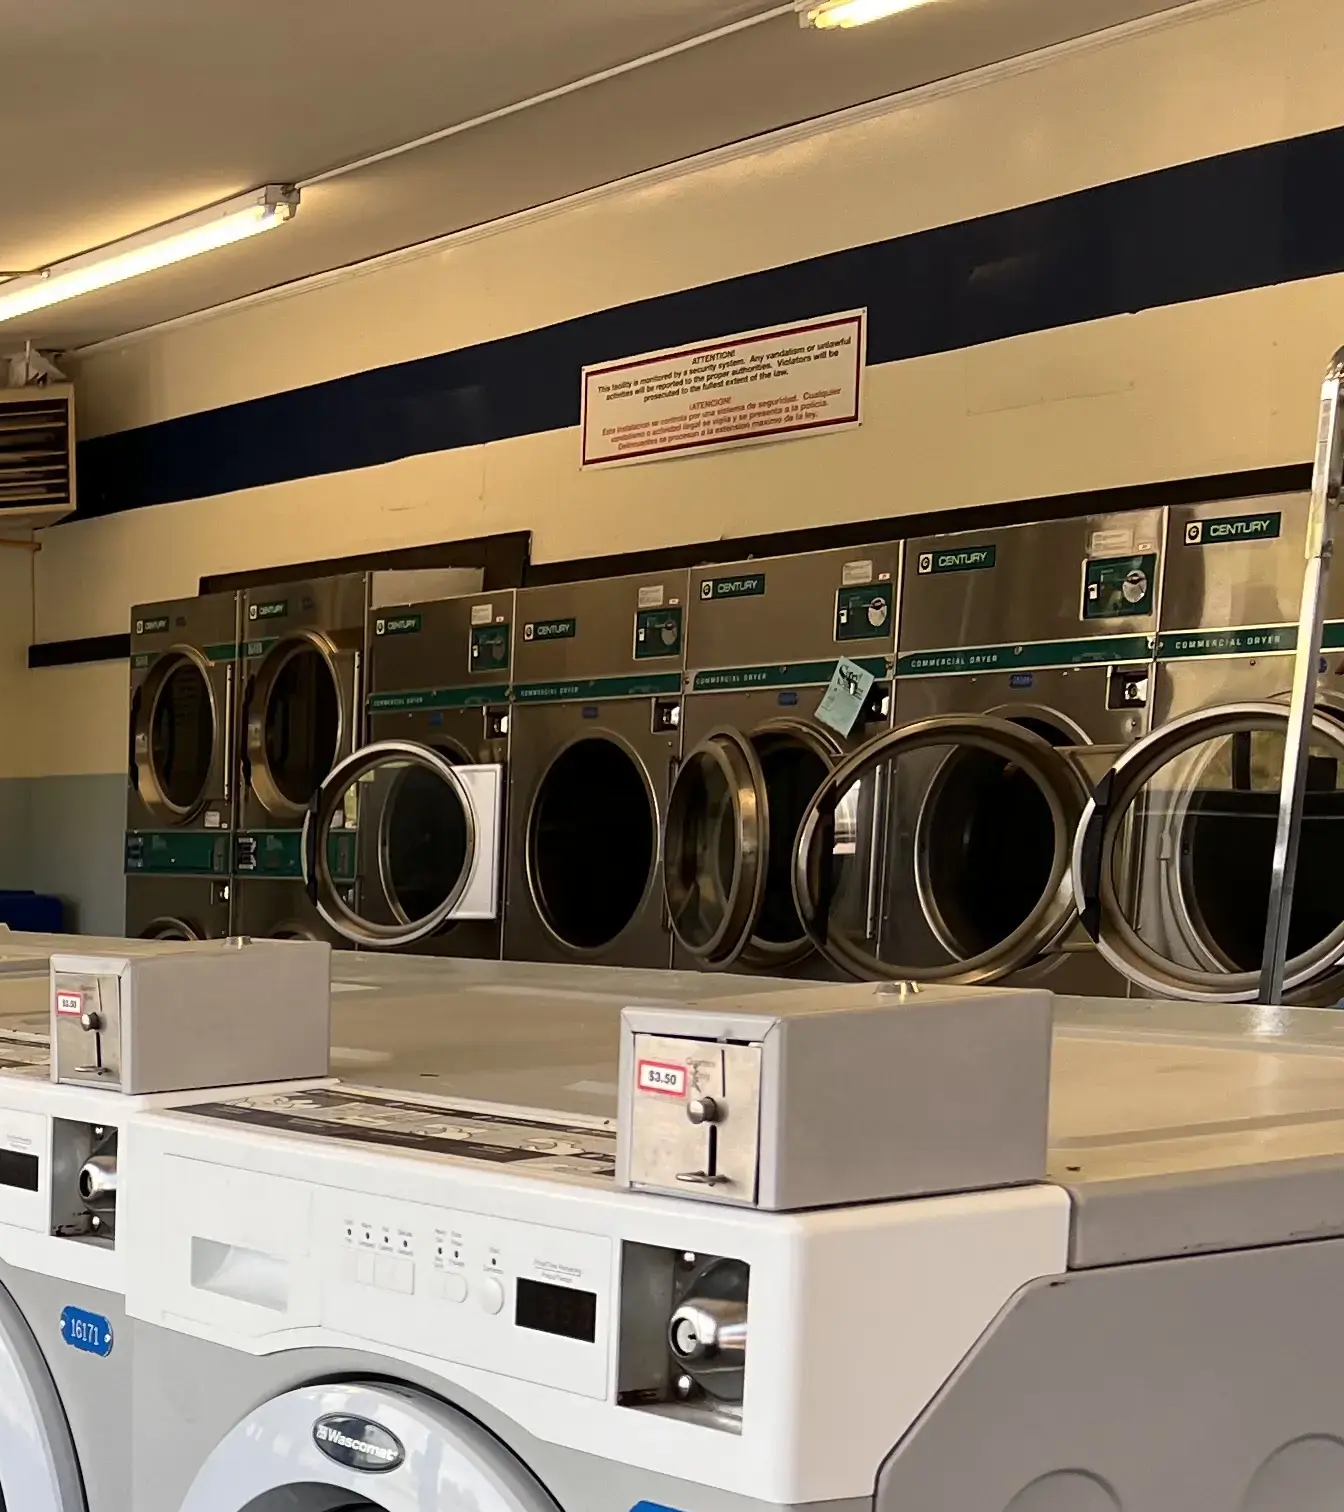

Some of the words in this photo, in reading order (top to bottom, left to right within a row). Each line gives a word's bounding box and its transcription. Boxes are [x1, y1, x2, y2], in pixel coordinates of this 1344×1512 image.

[611, 381, 631, 391] facility
[639, 373, 672, 384] monitored
[673, 371, 682, 379] by
[689, 364, 716, 376] security
[749, 355, 763, 365] Any
[766, 347, 804, 360] vandalism
[817, 338, 850, 350] unlawful
[691, 350, 735, 364] ATTENTION!
[655, 379, 683, 391] reported
[706, 372, 729, 382] proper
[777, 355, 811, 367] Violators
[813, 352, 825, 360] will
[643, 389, 678, 402] prosecuted
[702, 381, 723, 390] fullest
[725, 376, 748, 385] extent
[1210, 520, 1270, 537] CENTURY
[938, 552, 988, 566] CENTURY
[717, 580, 758, 594] CENTURY
[537, 624, 570, 636] CENTURY
[1175, 638, 1242, 649] COMMERCIAL
[1246, 634, 1281, 646] DRYER
[911, 658, 964, 668] COMMERCIAL
[970, 654, 998, 664] DRYER
[696, 675, 740, 686] COMMERCIAL
[744, 672, 766, 682] DRYER
[648, 1070, 677, 1085] $3.50
[71, 1318, 99, 1346] 16171
[328, 1428, 398, 1461] Wascomat
